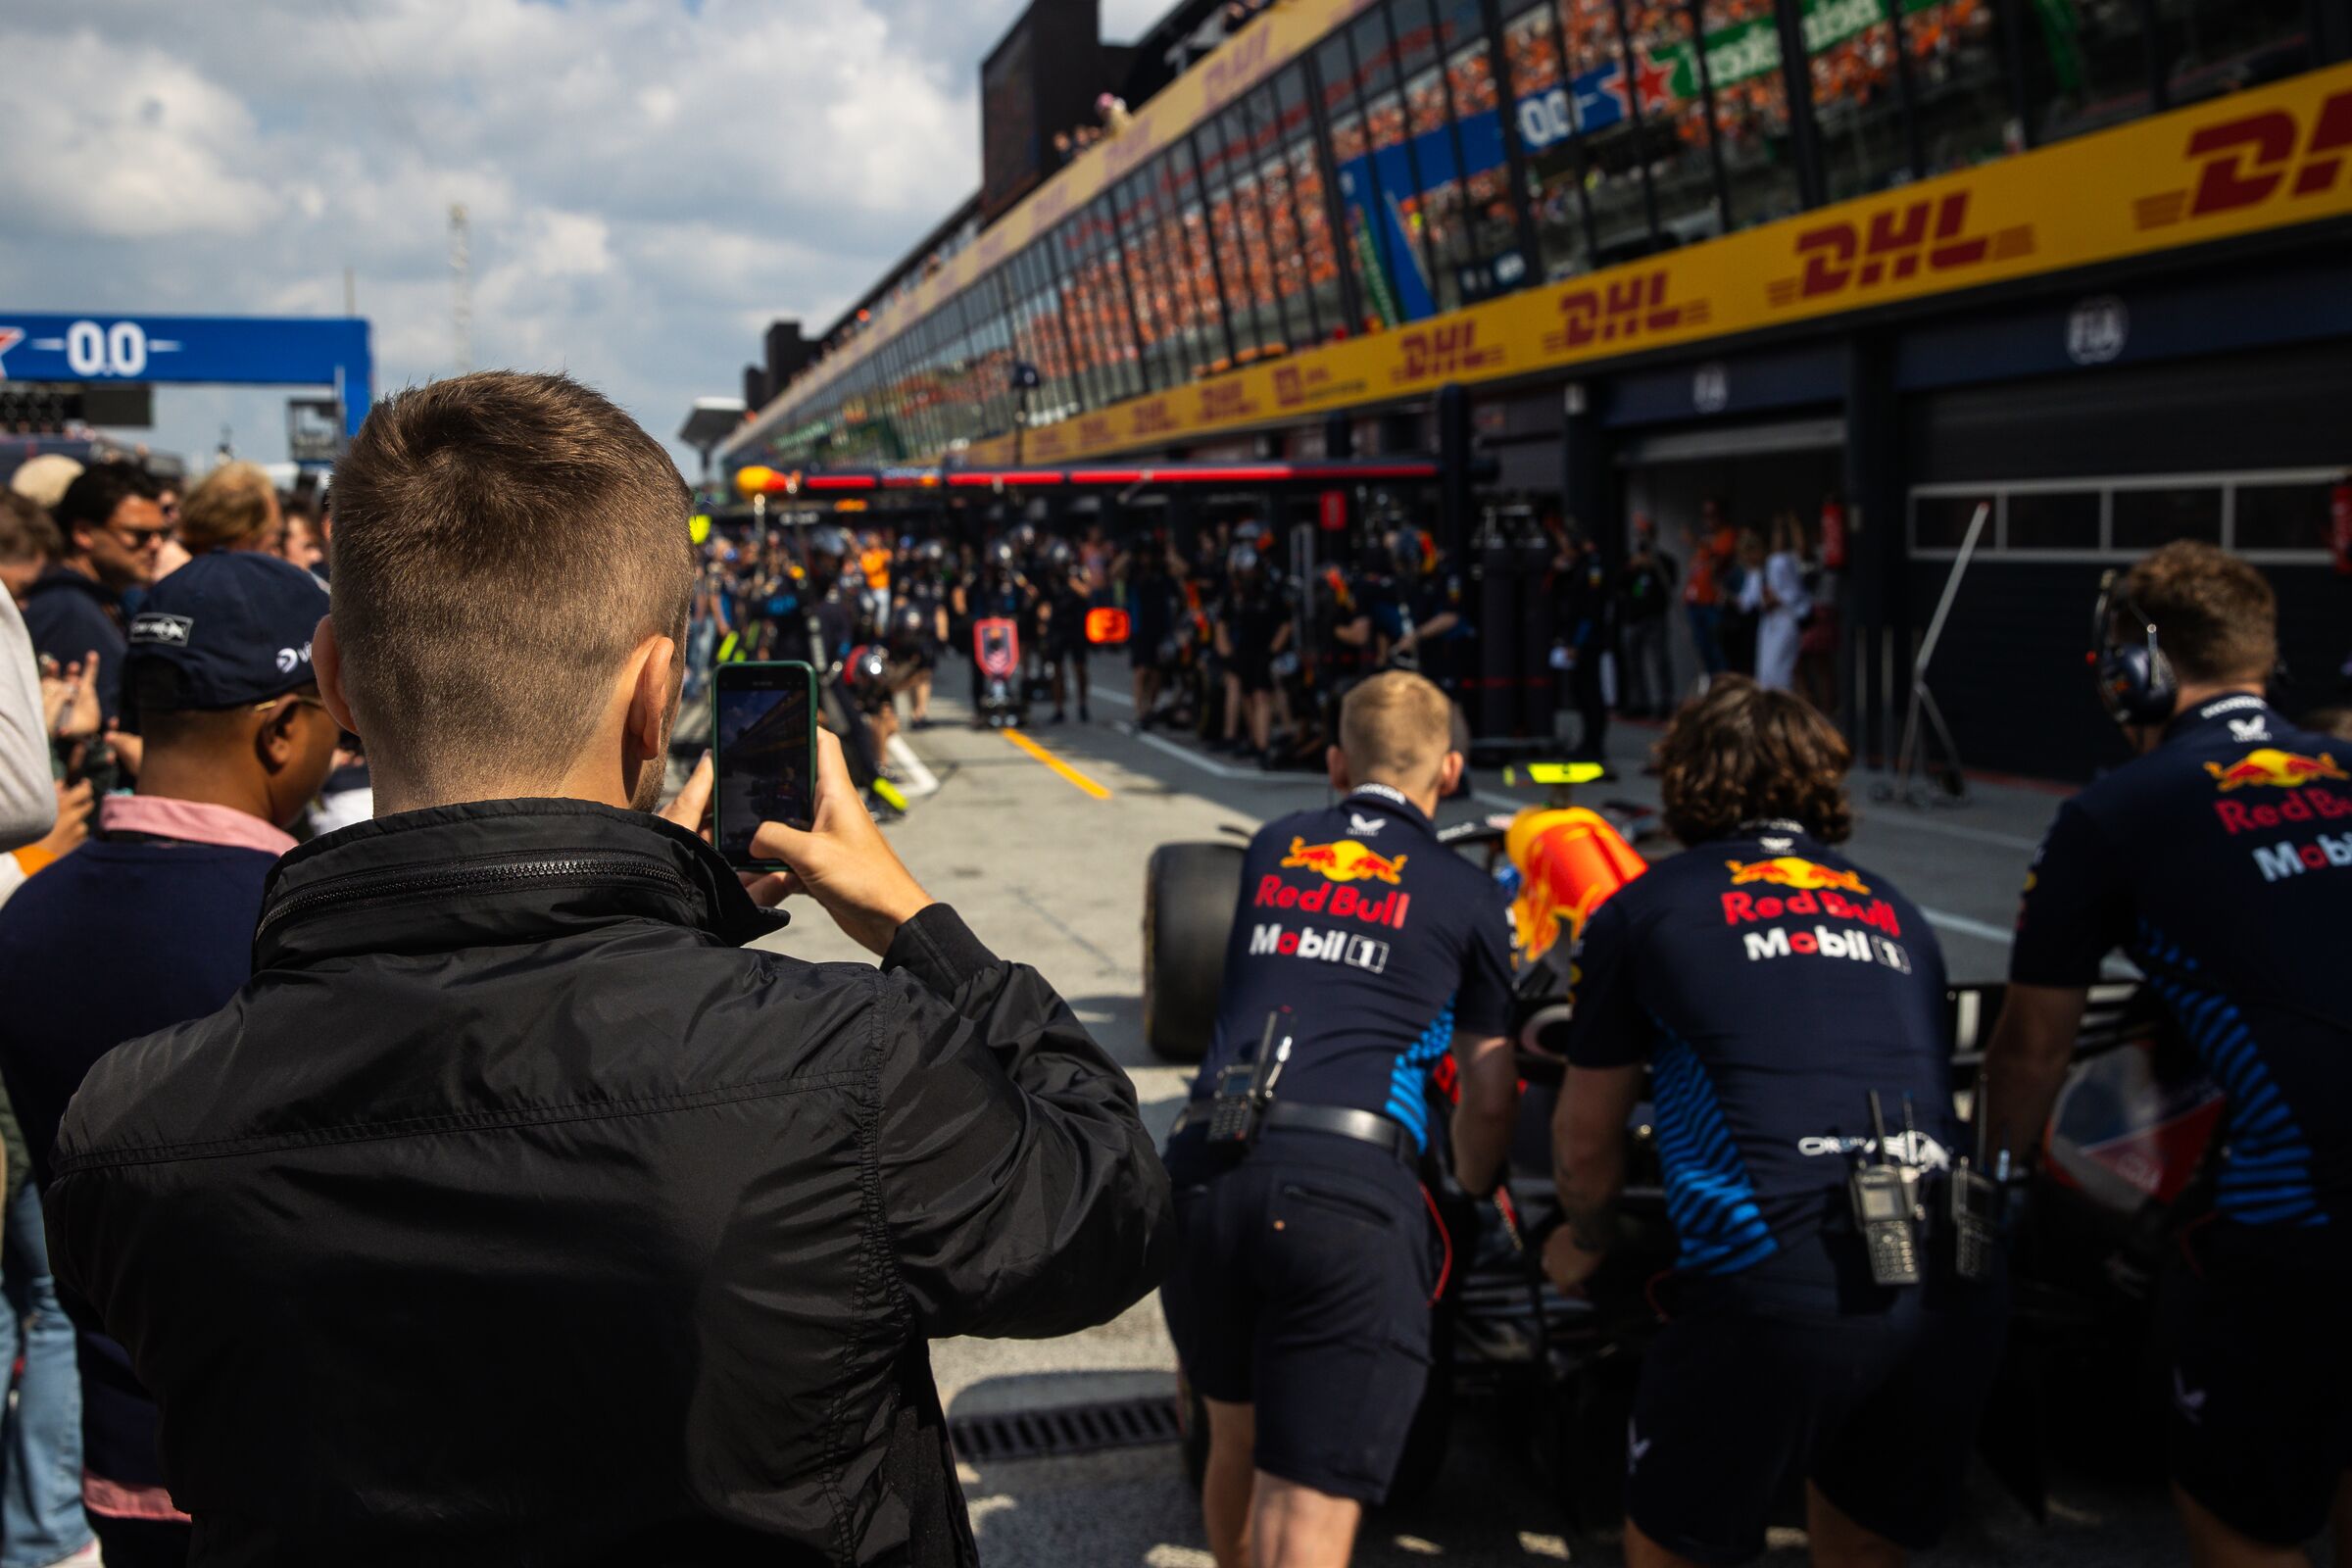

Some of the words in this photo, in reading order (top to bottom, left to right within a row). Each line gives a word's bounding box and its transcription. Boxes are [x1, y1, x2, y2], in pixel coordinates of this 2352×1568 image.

[1796, 190, 1988, 297] DHL
[1561, 270, 1681, 348] DHL
[1401, 319, 1486, 378] DHL
[2216, 791, 2313, 834] Red
[1255, 875, 1330, 911] Red
[1330, 884, 1410, 929] Bull
[1722, 891, 1818, 926] Red
[1819, 893, 1900, 937] Bull
[1250, 924, 1347, 962] Mobil
[1743, 926, 1873, 962] Mobil
